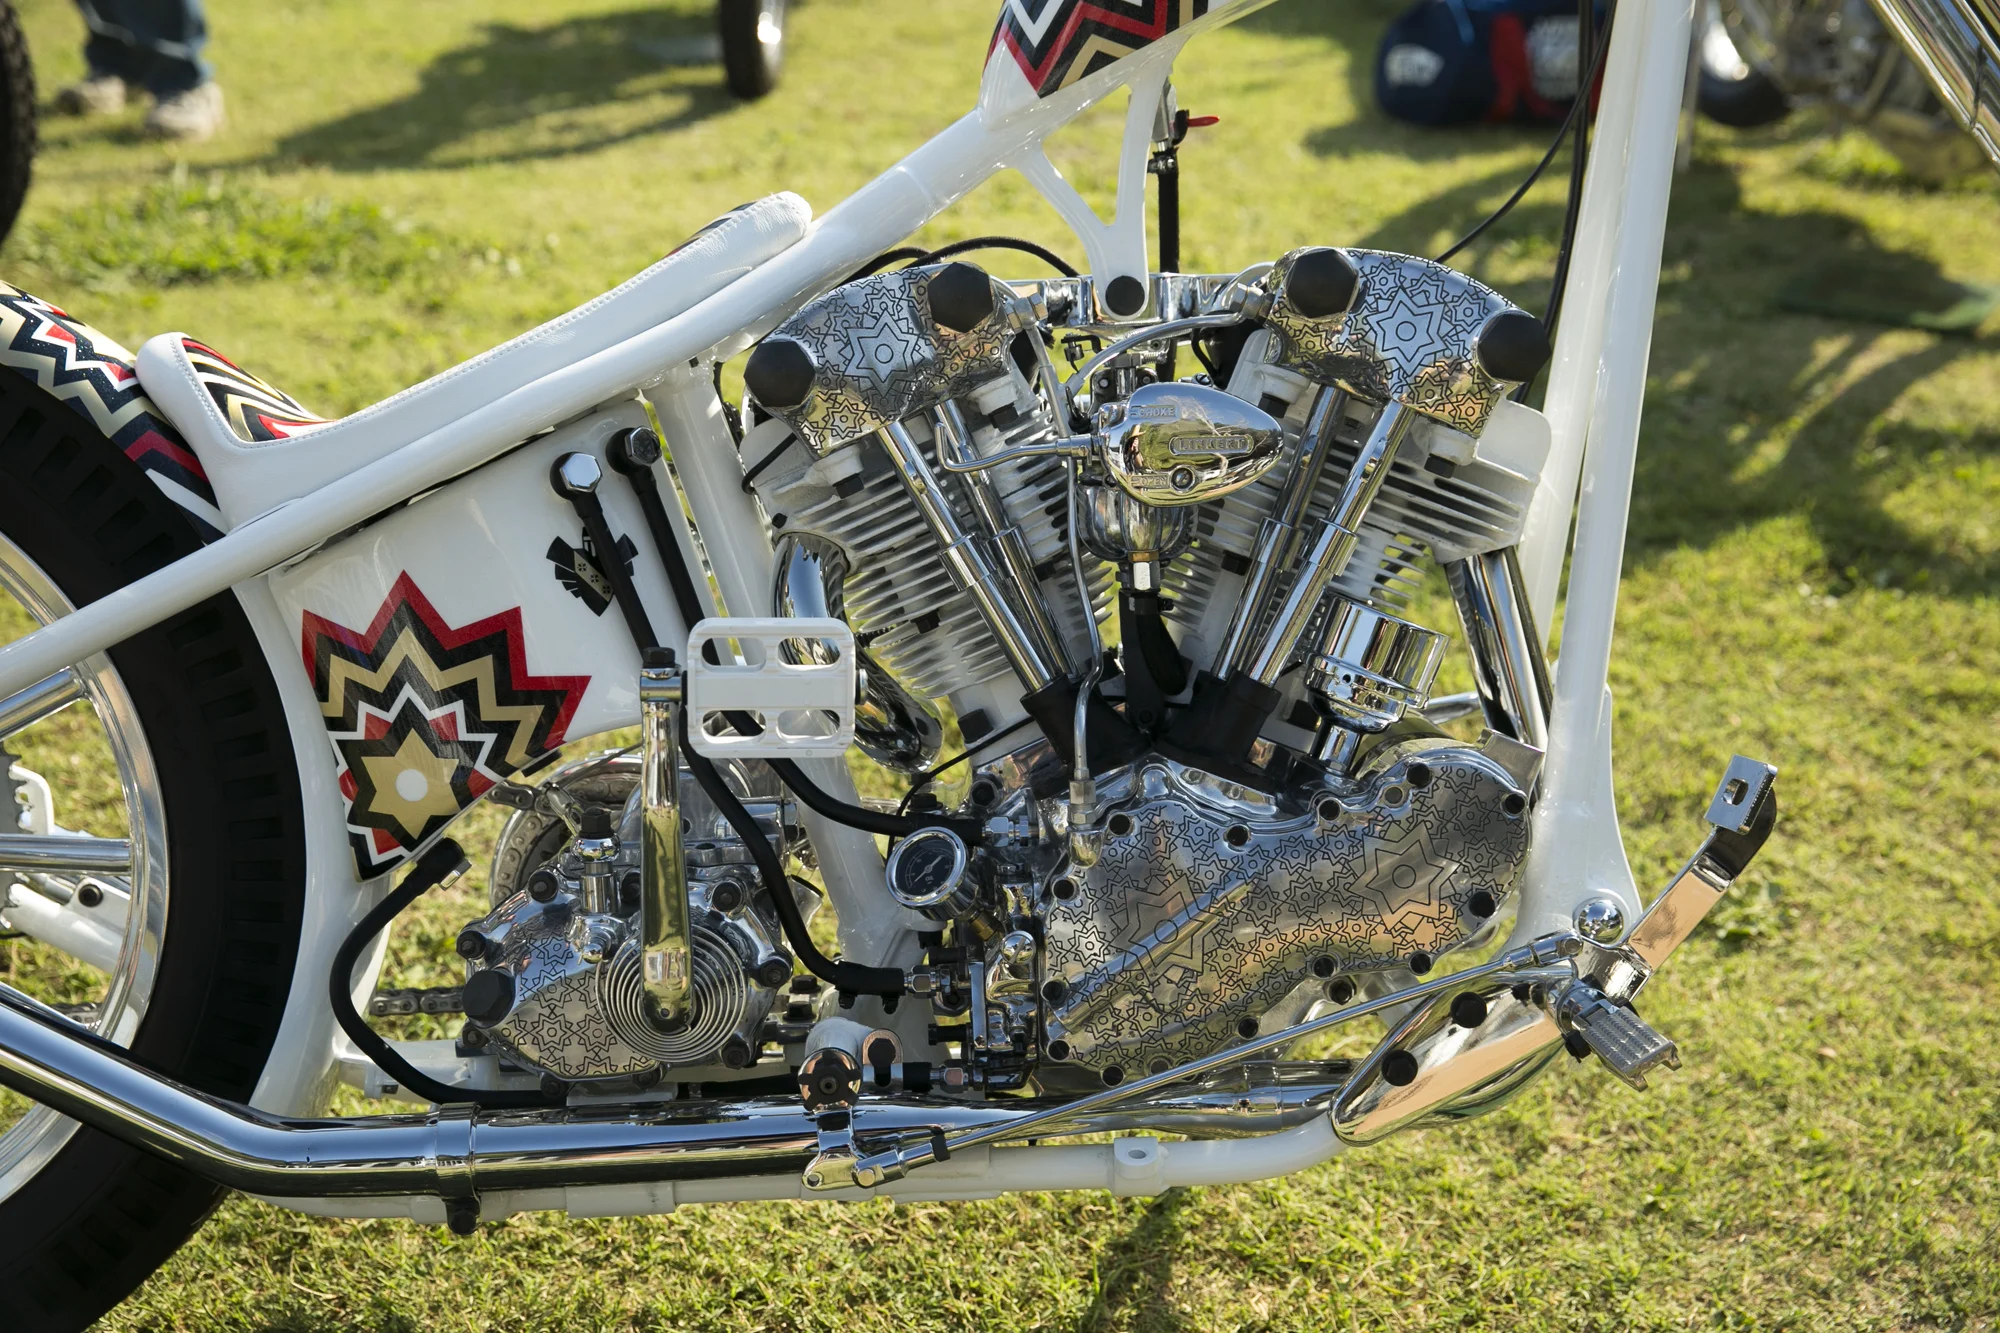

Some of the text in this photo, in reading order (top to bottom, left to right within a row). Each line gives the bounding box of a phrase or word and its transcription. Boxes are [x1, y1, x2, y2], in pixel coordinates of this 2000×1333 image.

[1138, 407, 1175, 417] CHOKE
[1179, 438, 1245, 450] LINKERT
[1141, 476, 1168, 486] OPEN
